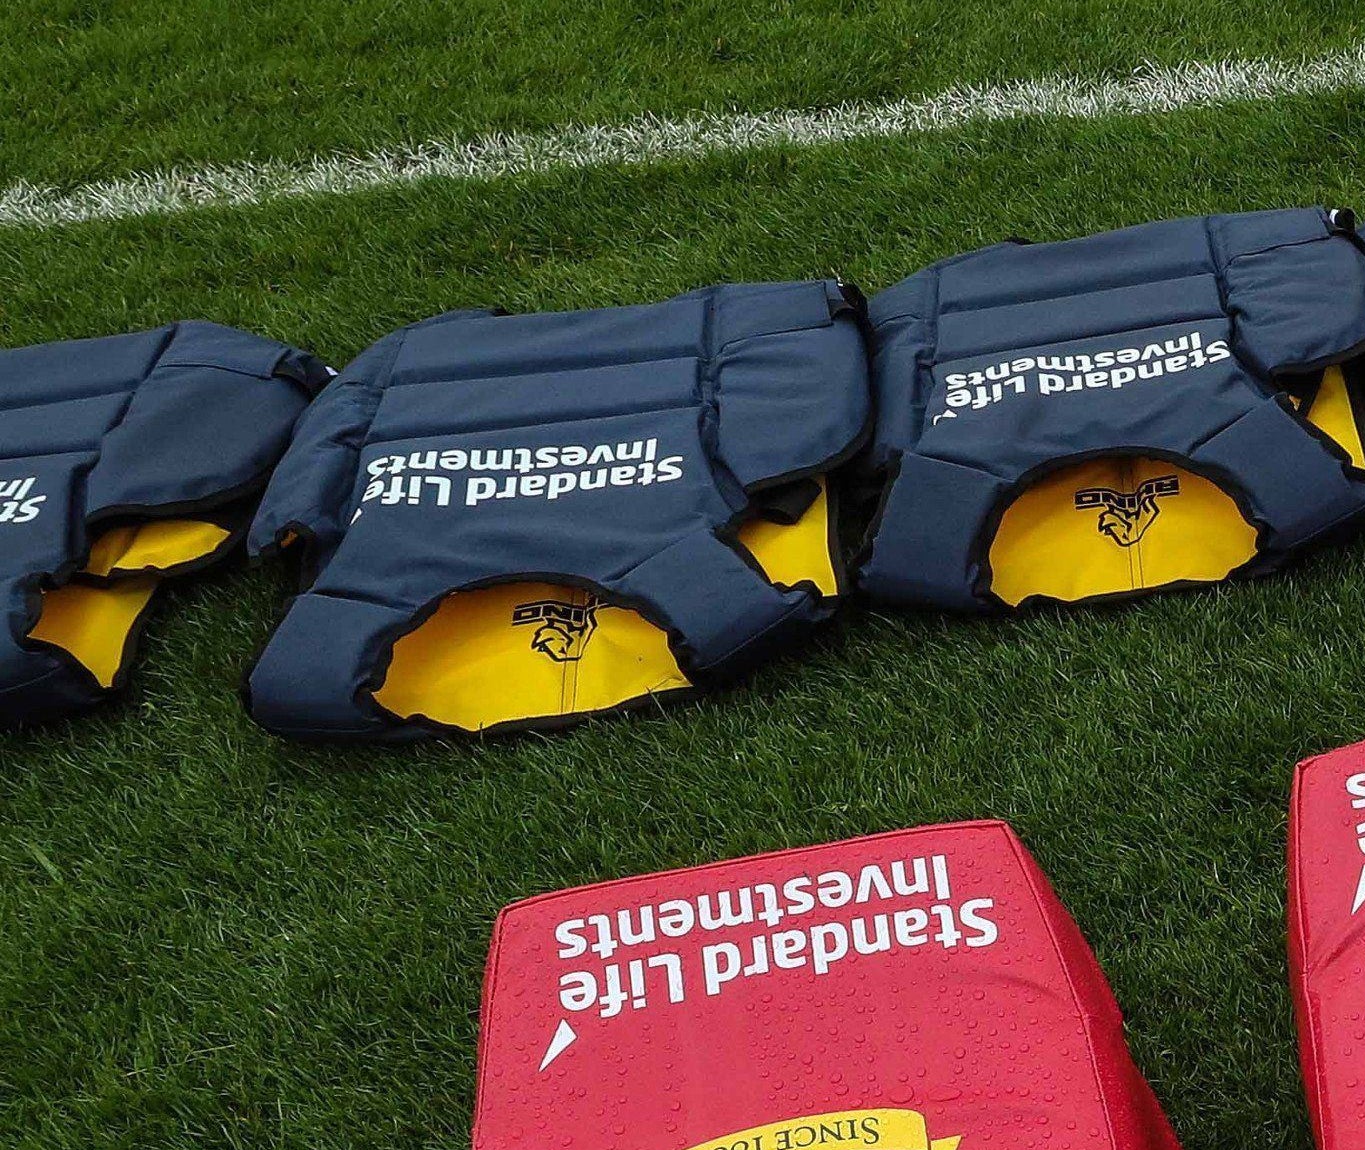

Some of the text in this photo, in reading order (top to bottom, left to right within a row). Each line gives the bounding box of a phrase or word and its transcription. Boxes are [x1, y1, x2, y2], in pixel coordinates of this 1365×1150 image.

[945, 331, 1201, 391] Investments
[945, 340, 1231, 411] Standard Life
[362, 456, 684, 506] Standard Life
[366, 437, 658, 480] Investments
[555, 854, 950, 960] Investments
[558, 898, 998, 1019] Standard Life
